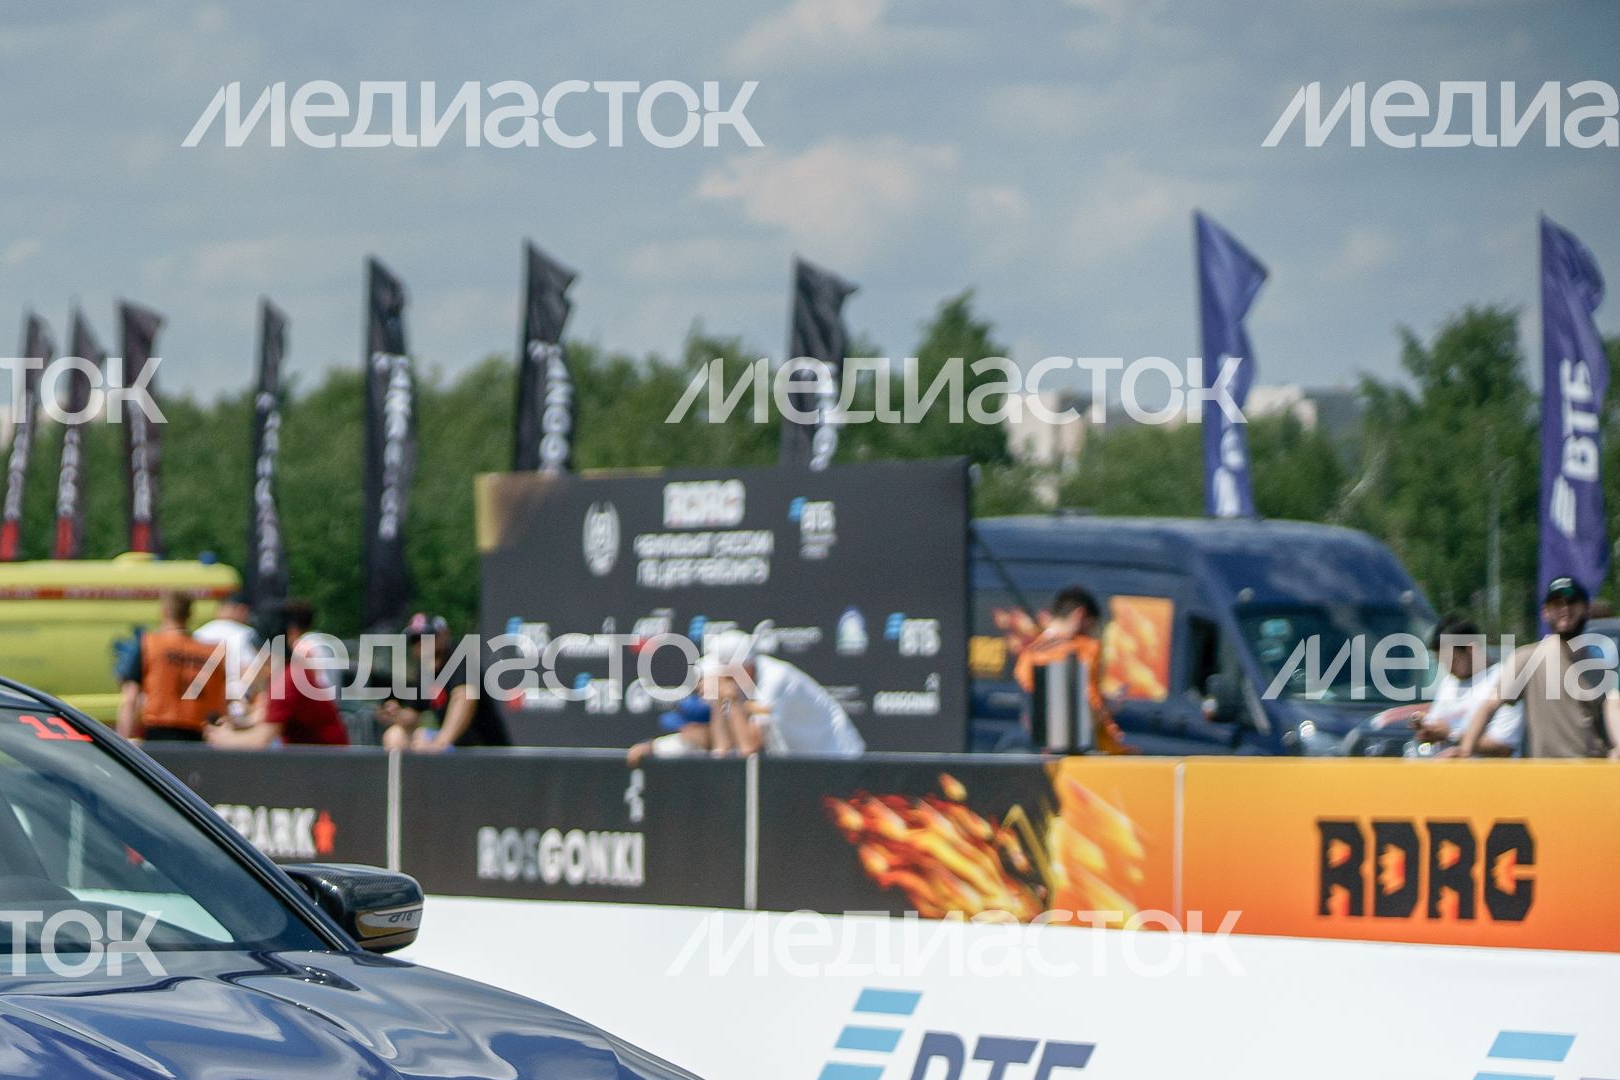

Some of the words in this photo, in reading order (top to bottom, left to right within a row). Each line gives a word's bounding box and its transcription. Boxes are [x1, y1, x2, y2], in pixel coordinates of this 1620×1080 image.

[19, 715, 93, 742] 11
[213, 804, 317, 858] PARK
[477, 826, 645, 886] ROSGONKI
[1315, 817, 1538, 923] RDRC
